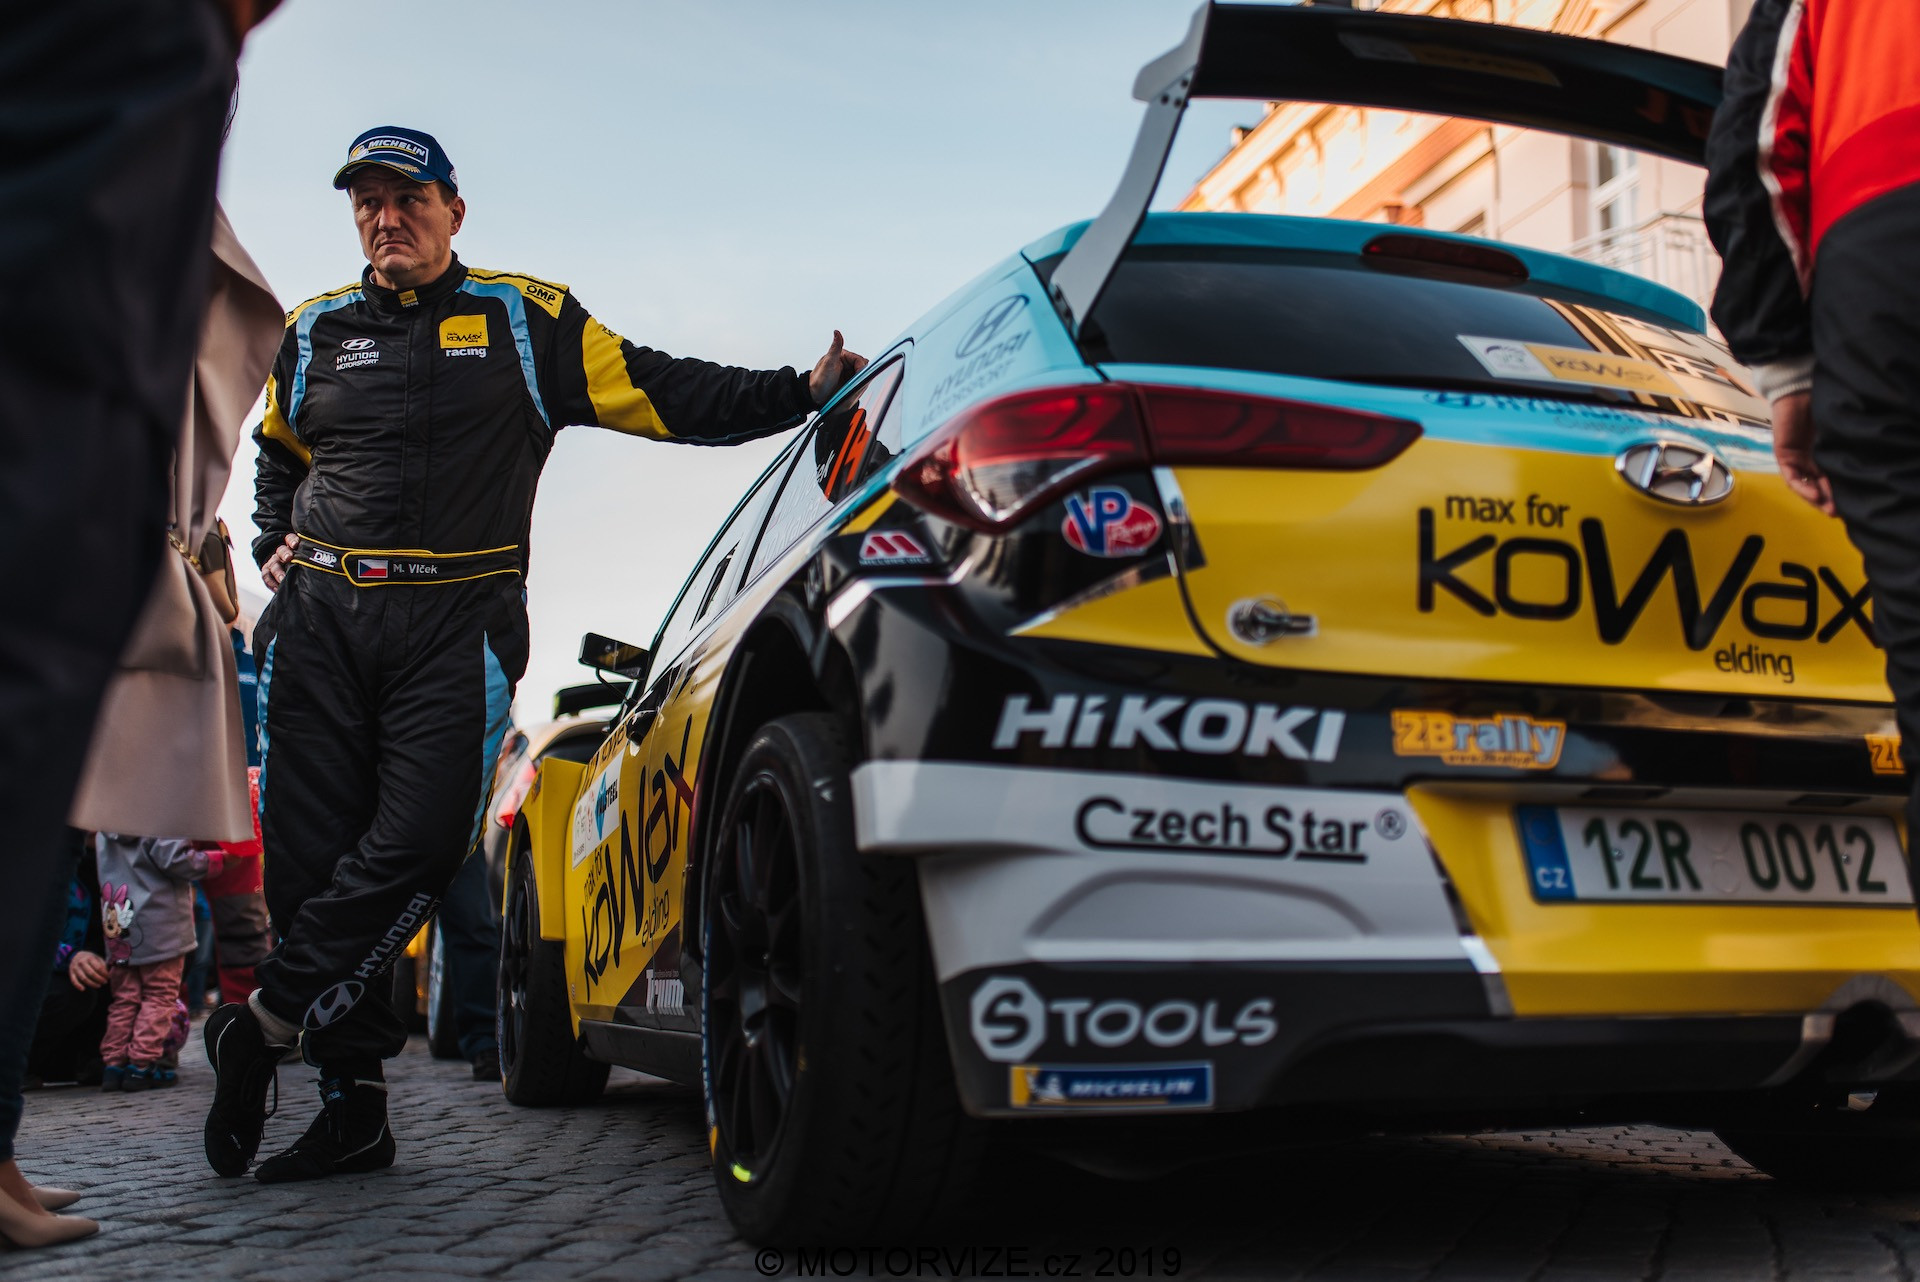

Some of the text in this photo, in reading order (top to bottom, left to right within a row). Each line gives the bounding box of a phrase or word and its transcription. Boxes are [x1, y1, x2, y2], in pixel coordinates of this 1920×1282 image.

[368, 140, 426, 157] MICHELIN
[526, 284, 556, 301] OMP
[336, 351, 379, 365] HYUNDAI
[336, 358, 379, 371] MOTORSPORT
[446, 347, 487, 358] racing
[929, 330, 1031, 406] HYUNDAI
[1066, 489, 1129, 553] VP
[1445, 493, 1571, 528] max for
[393, 563, 438, 574] M. Vlček
[1714, 644, 1795, 684] elding
[1074, 795, 1252, 852] Czech
[594, 846, 604, 881] for
[1583, 818, 1887, 894] 12R 0012
[1537, 868, 1568, 888] CZ
[354, 892, 432, 978] HYUNDAI
[642, 888, 670, 948] elding
[1069, 1077, 1196, 1097] MICHELIN
